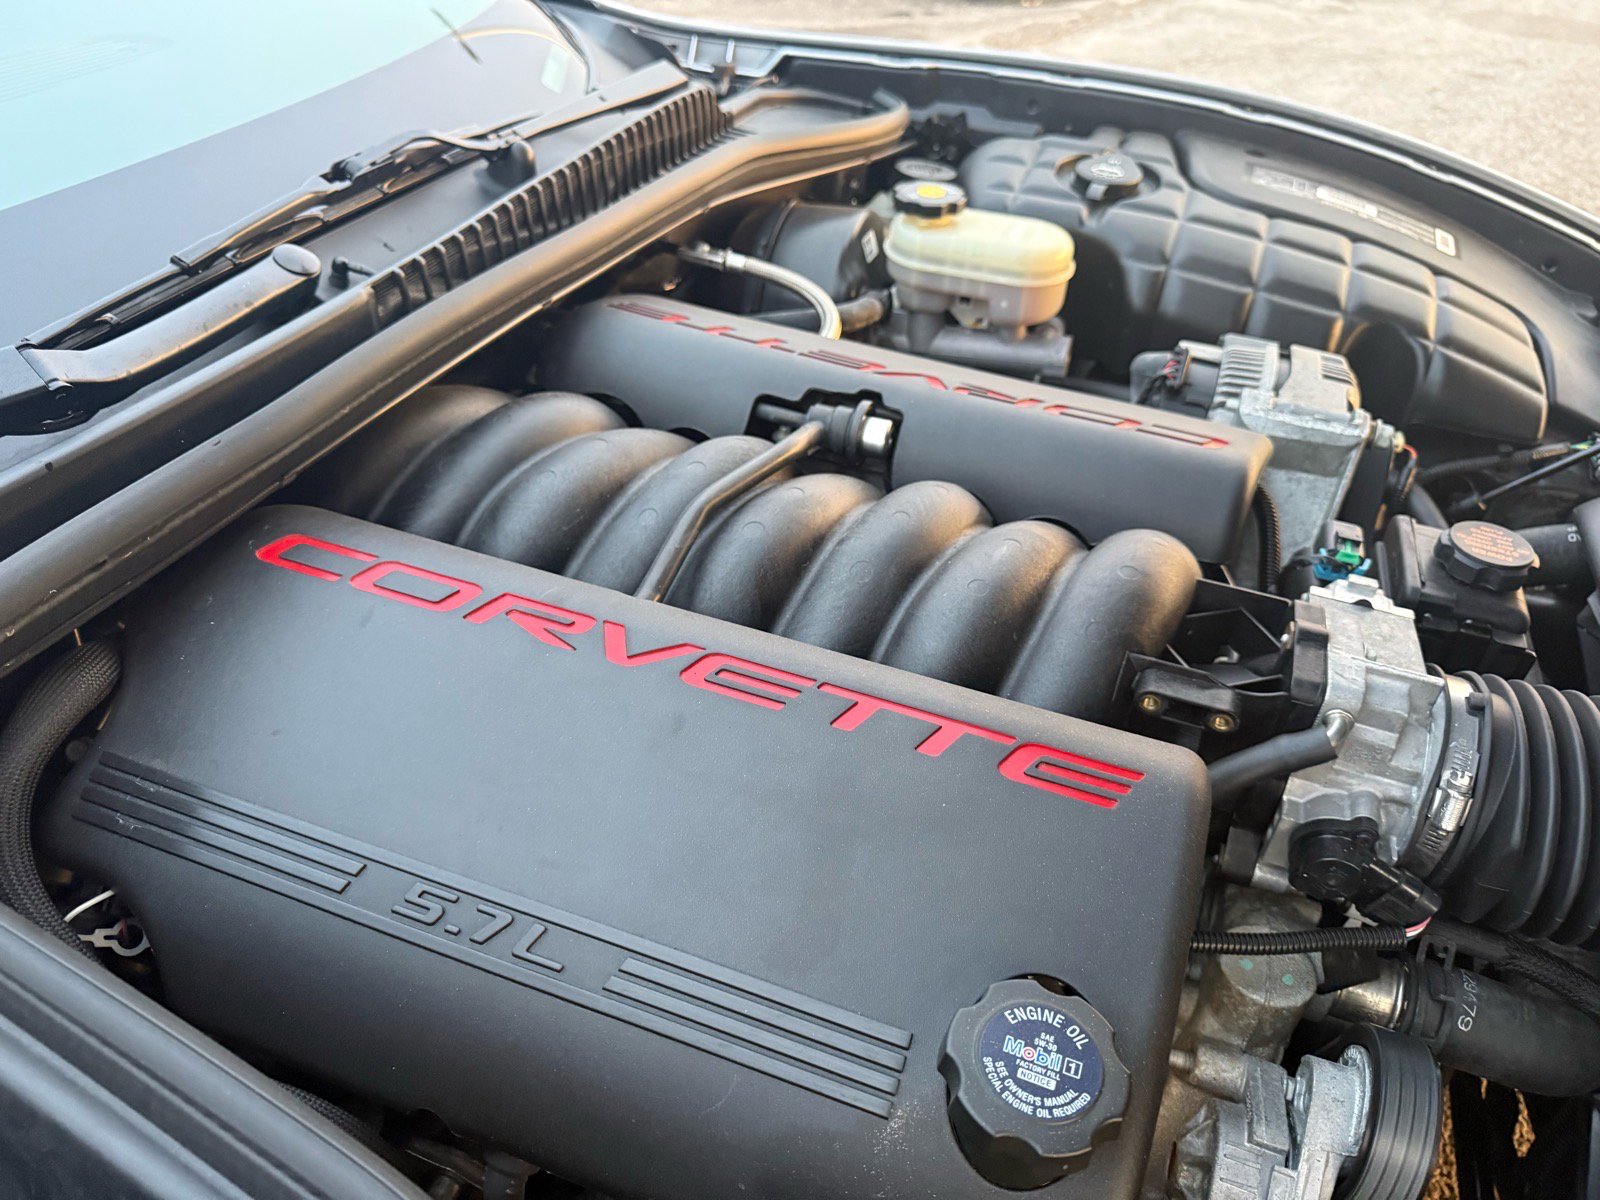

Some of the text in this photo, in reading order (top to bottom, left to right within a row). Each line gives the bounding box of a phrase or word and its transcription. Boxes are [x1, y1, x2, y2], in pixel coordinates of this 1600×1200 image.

[256, 533, 1145, 809] CORVETTE
[391, 882, 565, 973] 5.7L
[1004, 1006, 1089, 1050] ENGINE OIL
[1034, 1038, 1058, 1051] 5W-30
[1040, 1032, 1055, 1042] SAE
[1003, 1034, 1063, 1072] Mobil
[1016, 1058, 1061, 1081] FACTORY FILL
[983, 1056, 1091, 1118] SPECIAL ENGINE OIL REQUIRED
[995, 1061, 1079, 1107] SEE OWNER'S MANUAL
[1019, 1069, 1054, 1088] NOTICE
